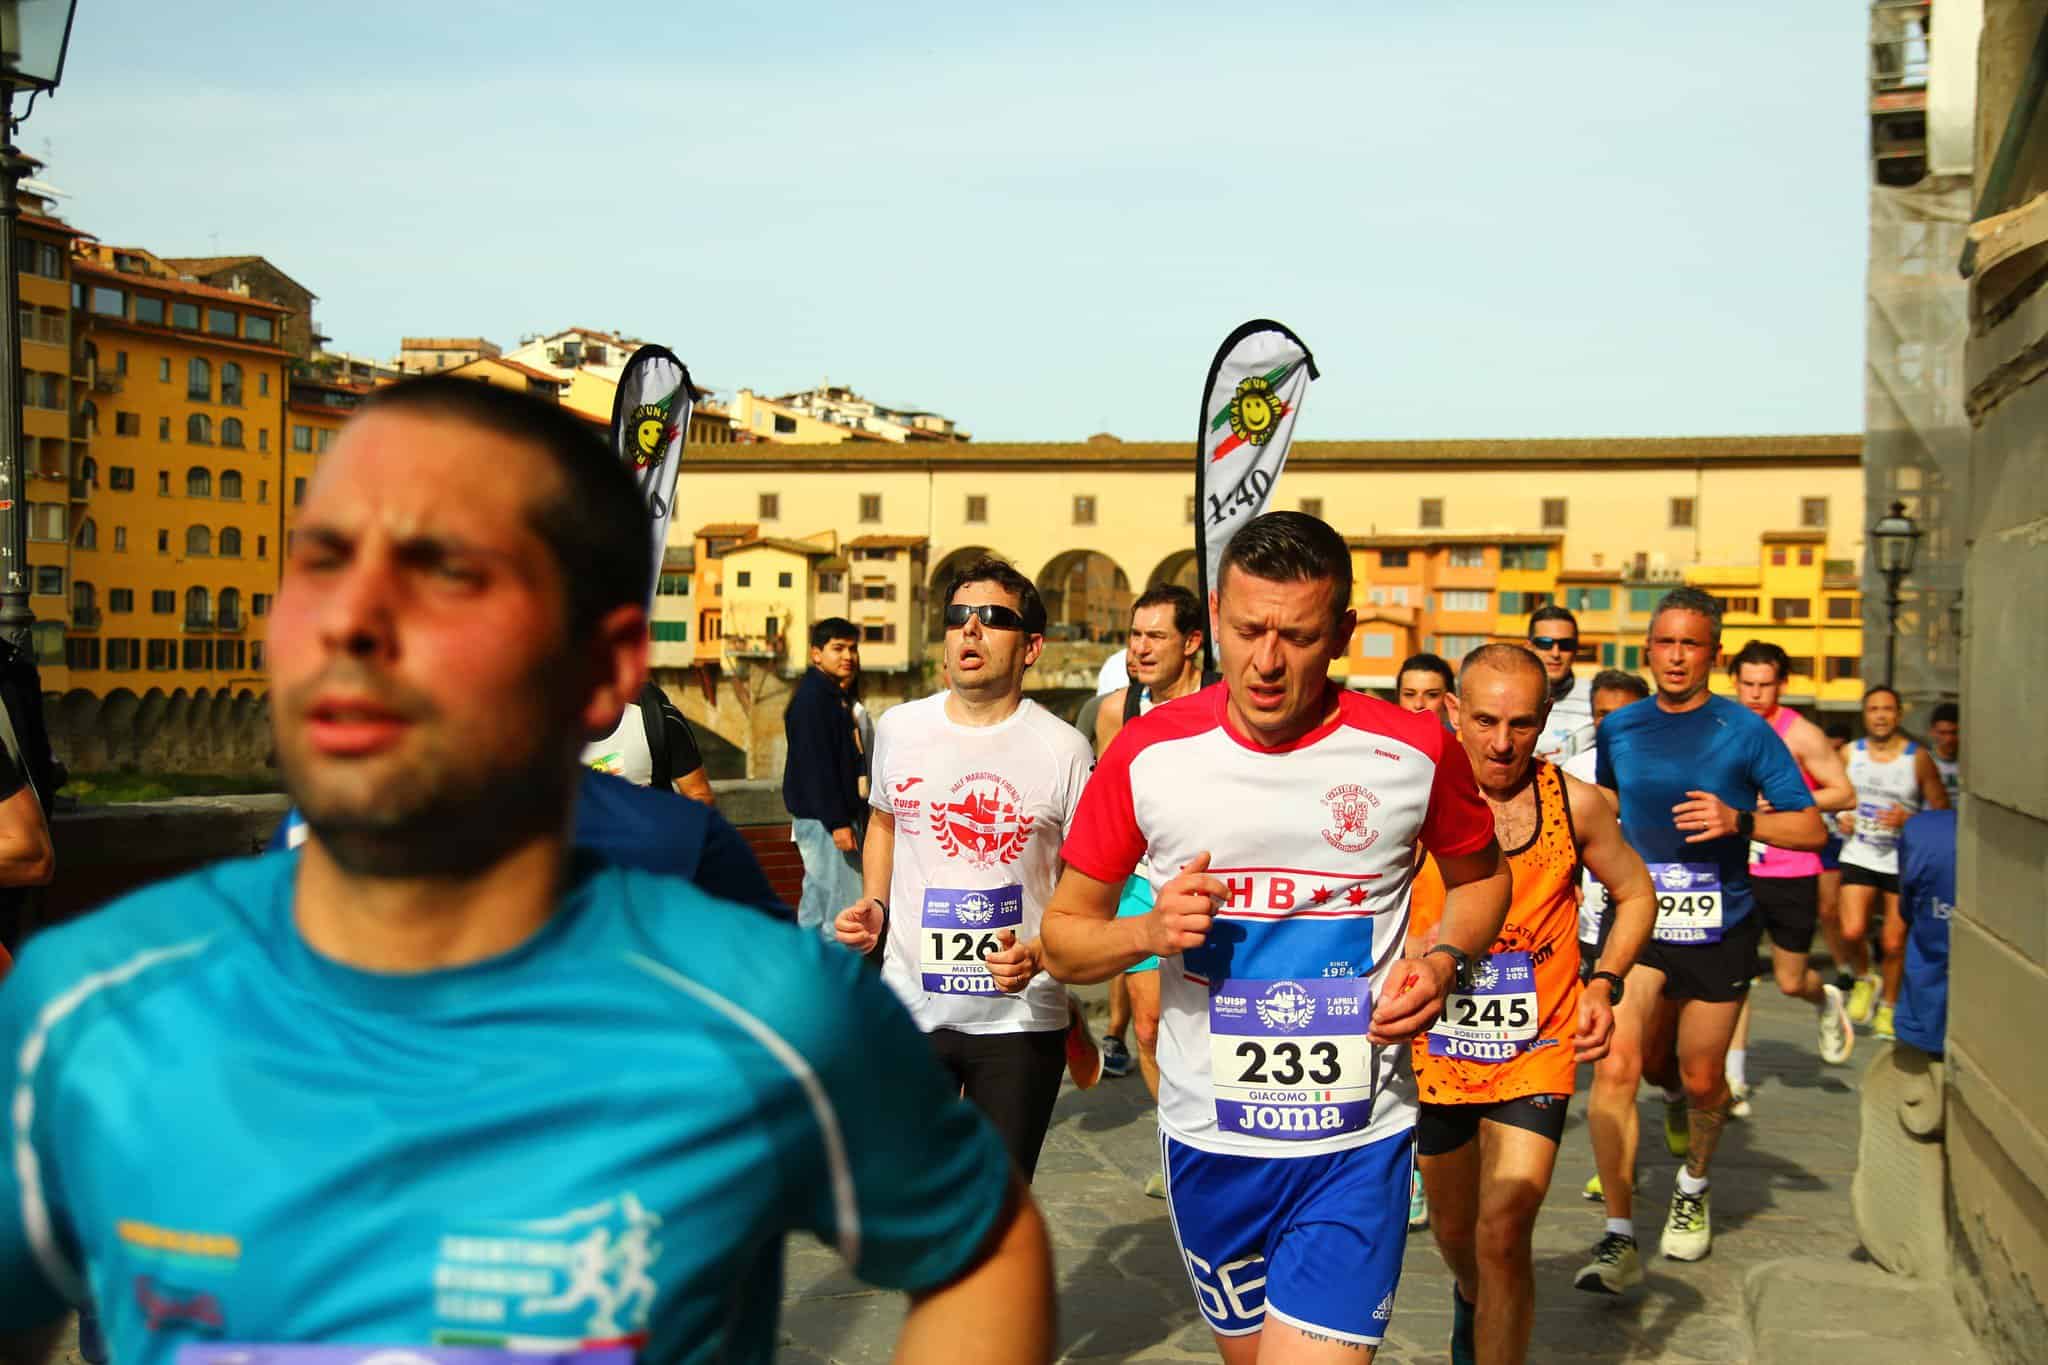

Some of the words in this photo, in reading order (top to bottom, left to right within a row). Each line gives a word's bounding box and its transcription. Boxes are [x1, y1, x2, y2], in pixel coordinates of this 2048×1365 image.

[931, 930, 1016, 961] 126
[940, 975, 995, 993] Jom
[1327, 1006, 1359, 1015] 2024
[1235, 1041, 1342, 1085] 233
[1249, 1091, 1308, 1103] GIACOMO
